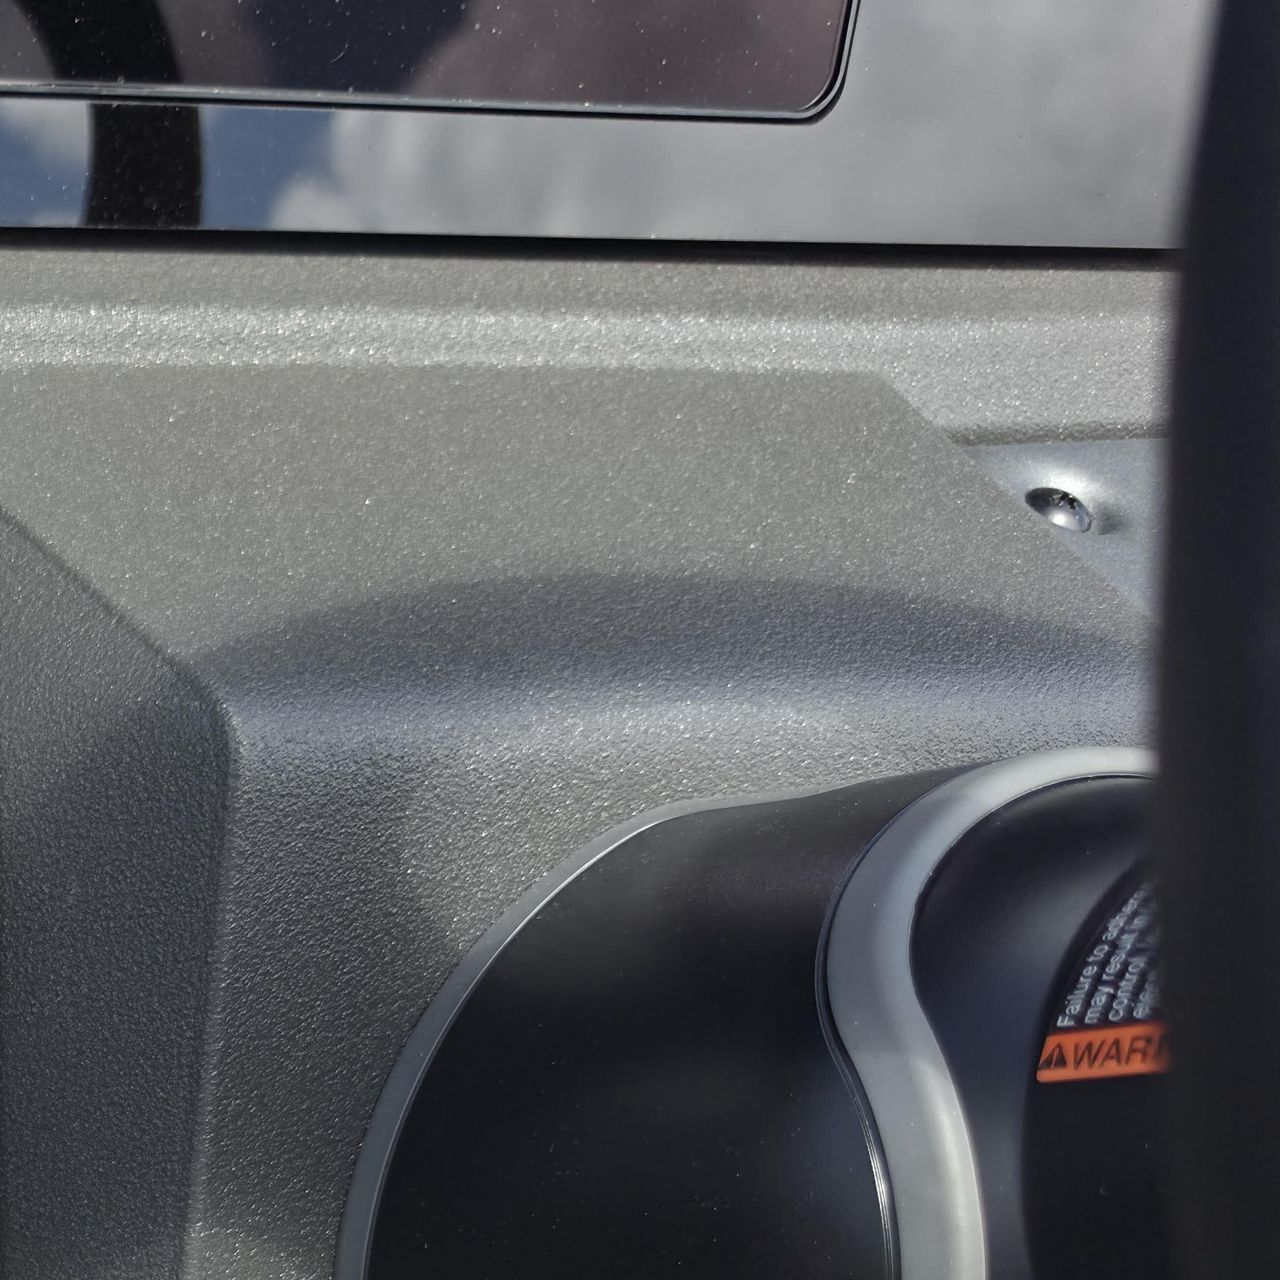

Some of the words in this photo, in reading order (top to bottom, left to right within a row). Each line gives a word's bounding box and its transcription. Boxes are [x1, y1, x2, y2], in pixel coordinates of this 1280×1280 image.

[1057, 965, 1098, 1028] Failure
[1086, 943, 1110, 962] to
[1084, 985, 1115, 1025] may
